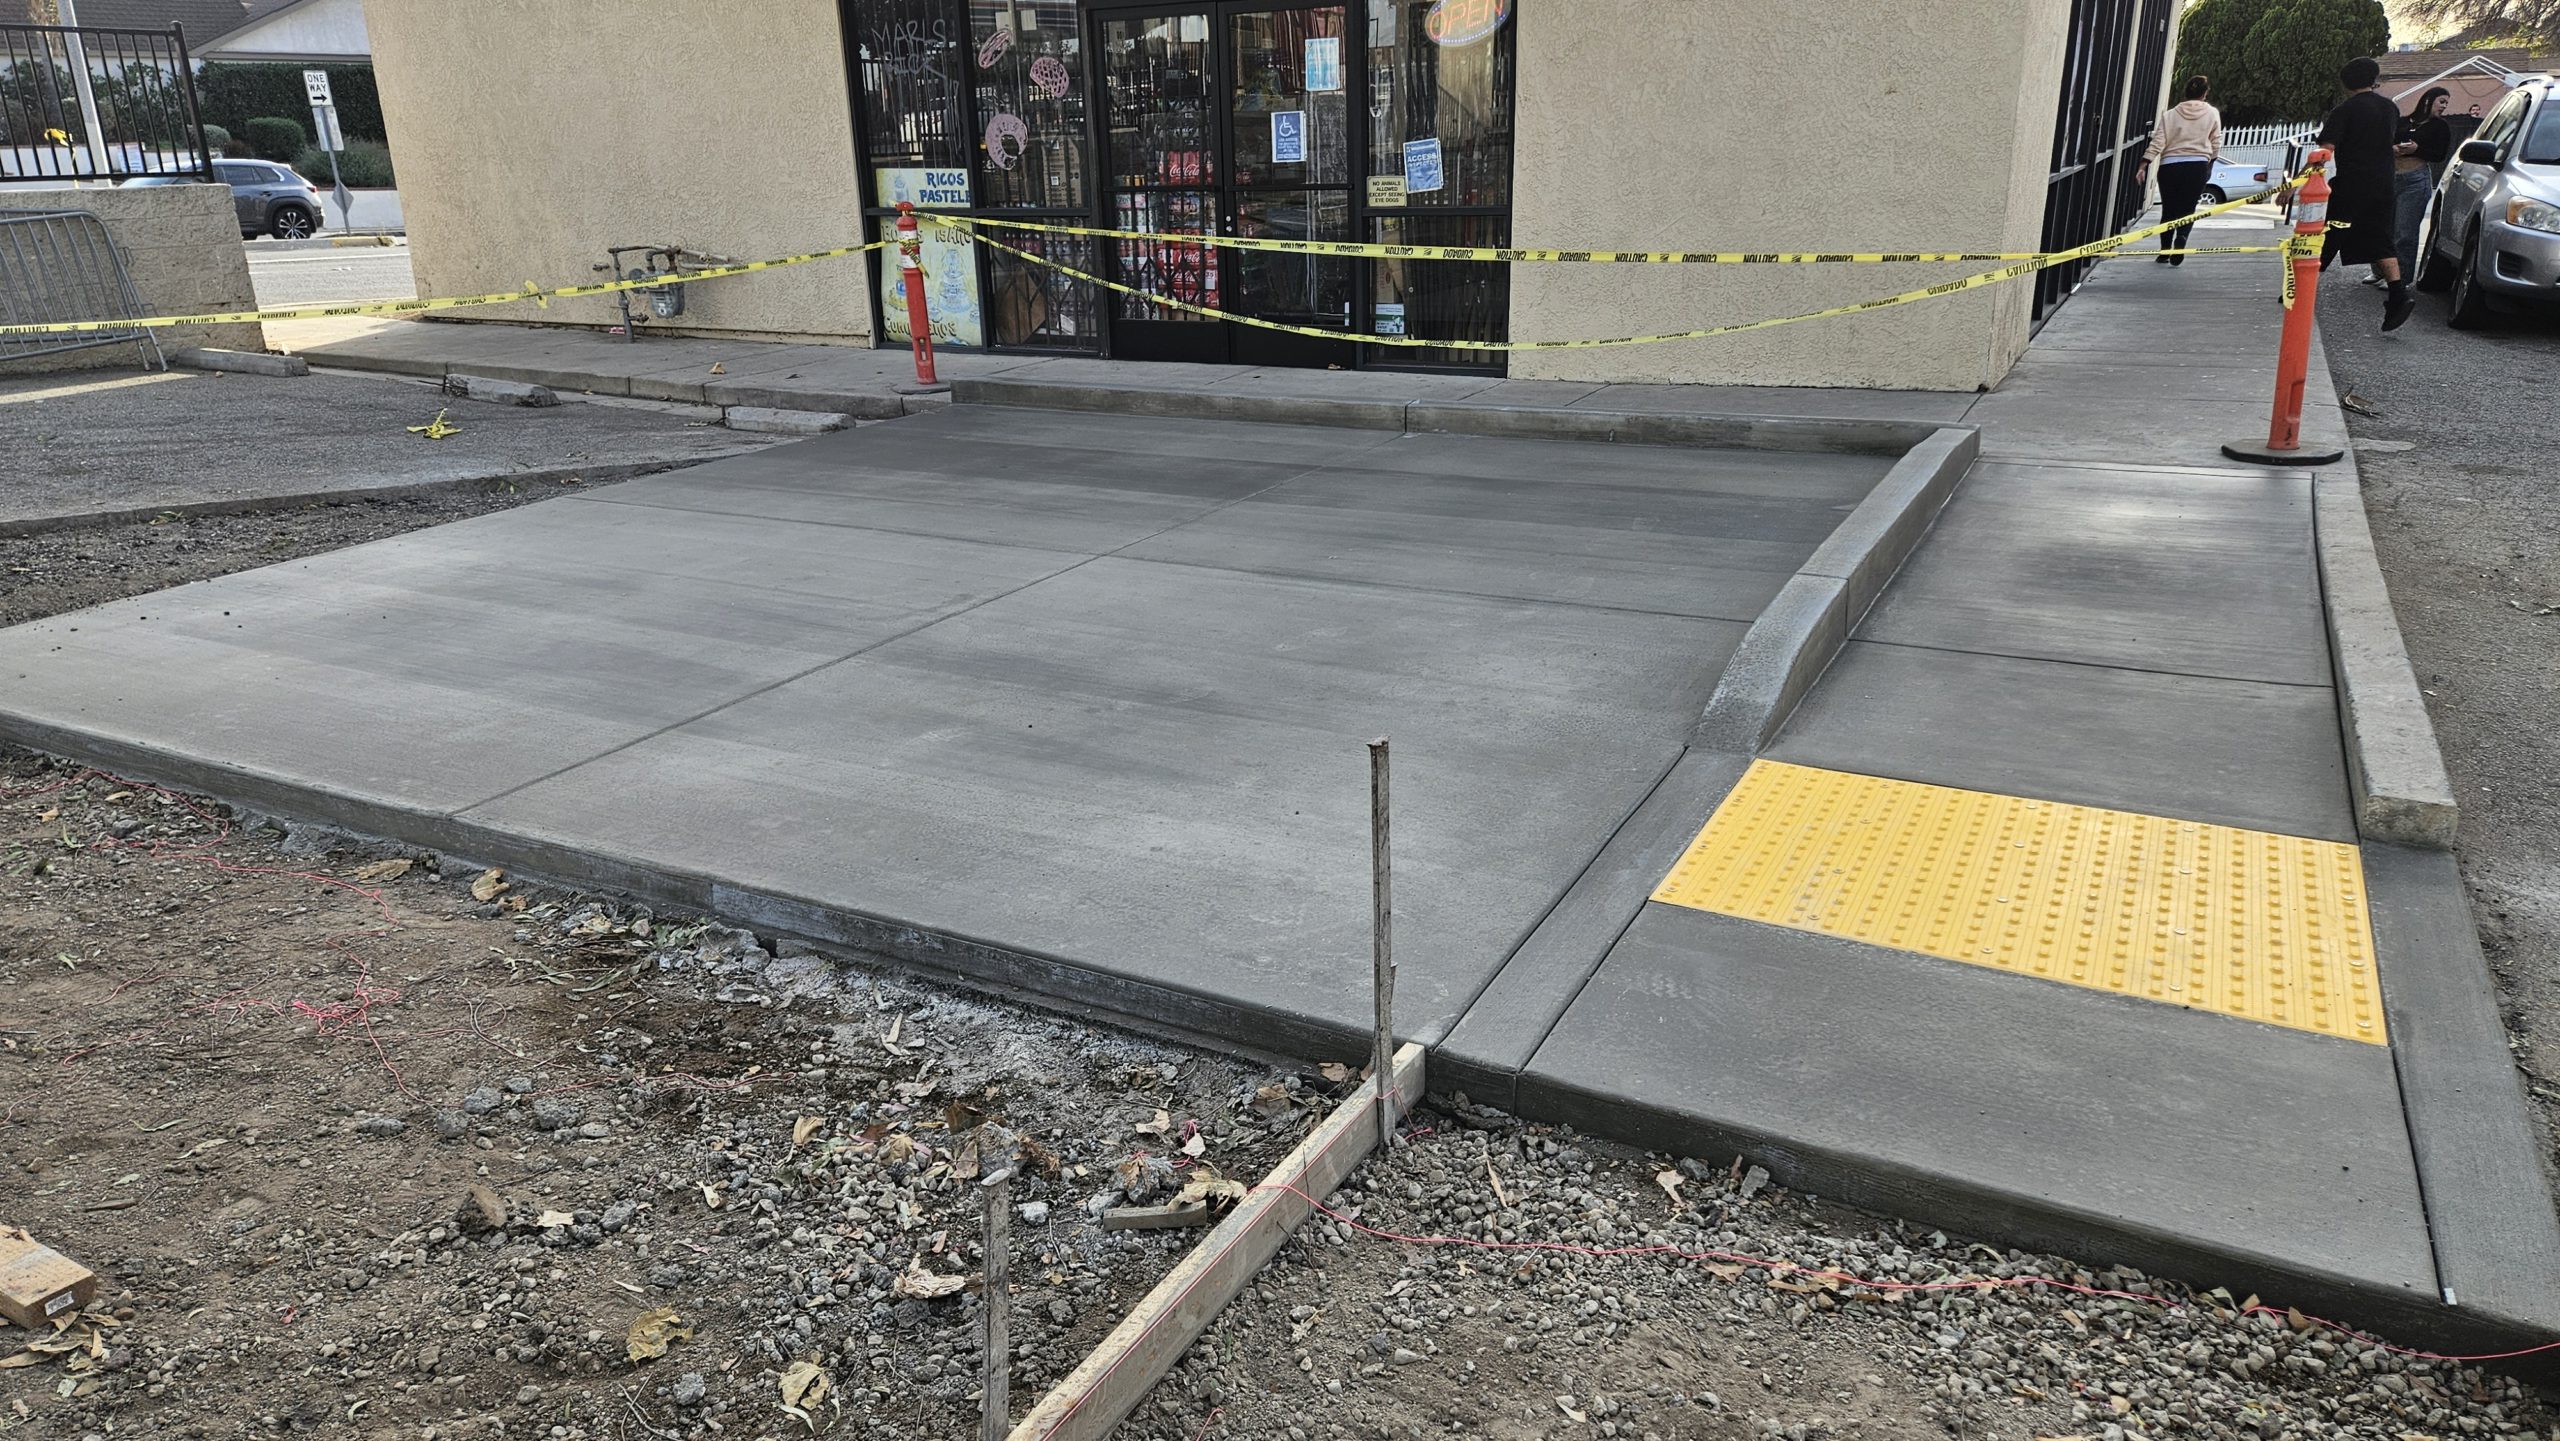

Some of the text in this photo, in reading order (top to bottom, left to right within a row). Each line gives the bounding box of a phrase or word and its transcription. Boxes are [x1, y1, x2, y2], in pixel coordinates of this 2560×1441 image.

[1430, 0, 1504, 38] OPEN
[307, 74, 326, 82] ONE
[309, 84, 326, 92] WAY
[1407, 152, 1437, 162] ACCESS
[926, 172, 964, 188] RICOS
[1384, 246, 1413, 256] CAUTION
[1443, 249, 1473, 258] CUIDADO
[1495, 250, 1526, 260] CAUTION
[1558, 252, 1590, 262] CUIDADO
[1615, 252, 1647, 262] CAUTION
[1682, 254, 1717, 263] CUIDADO
[1743, 254, 1778, 263] CAUTION
[1222, 312, 1248, 323] CUIDADO
